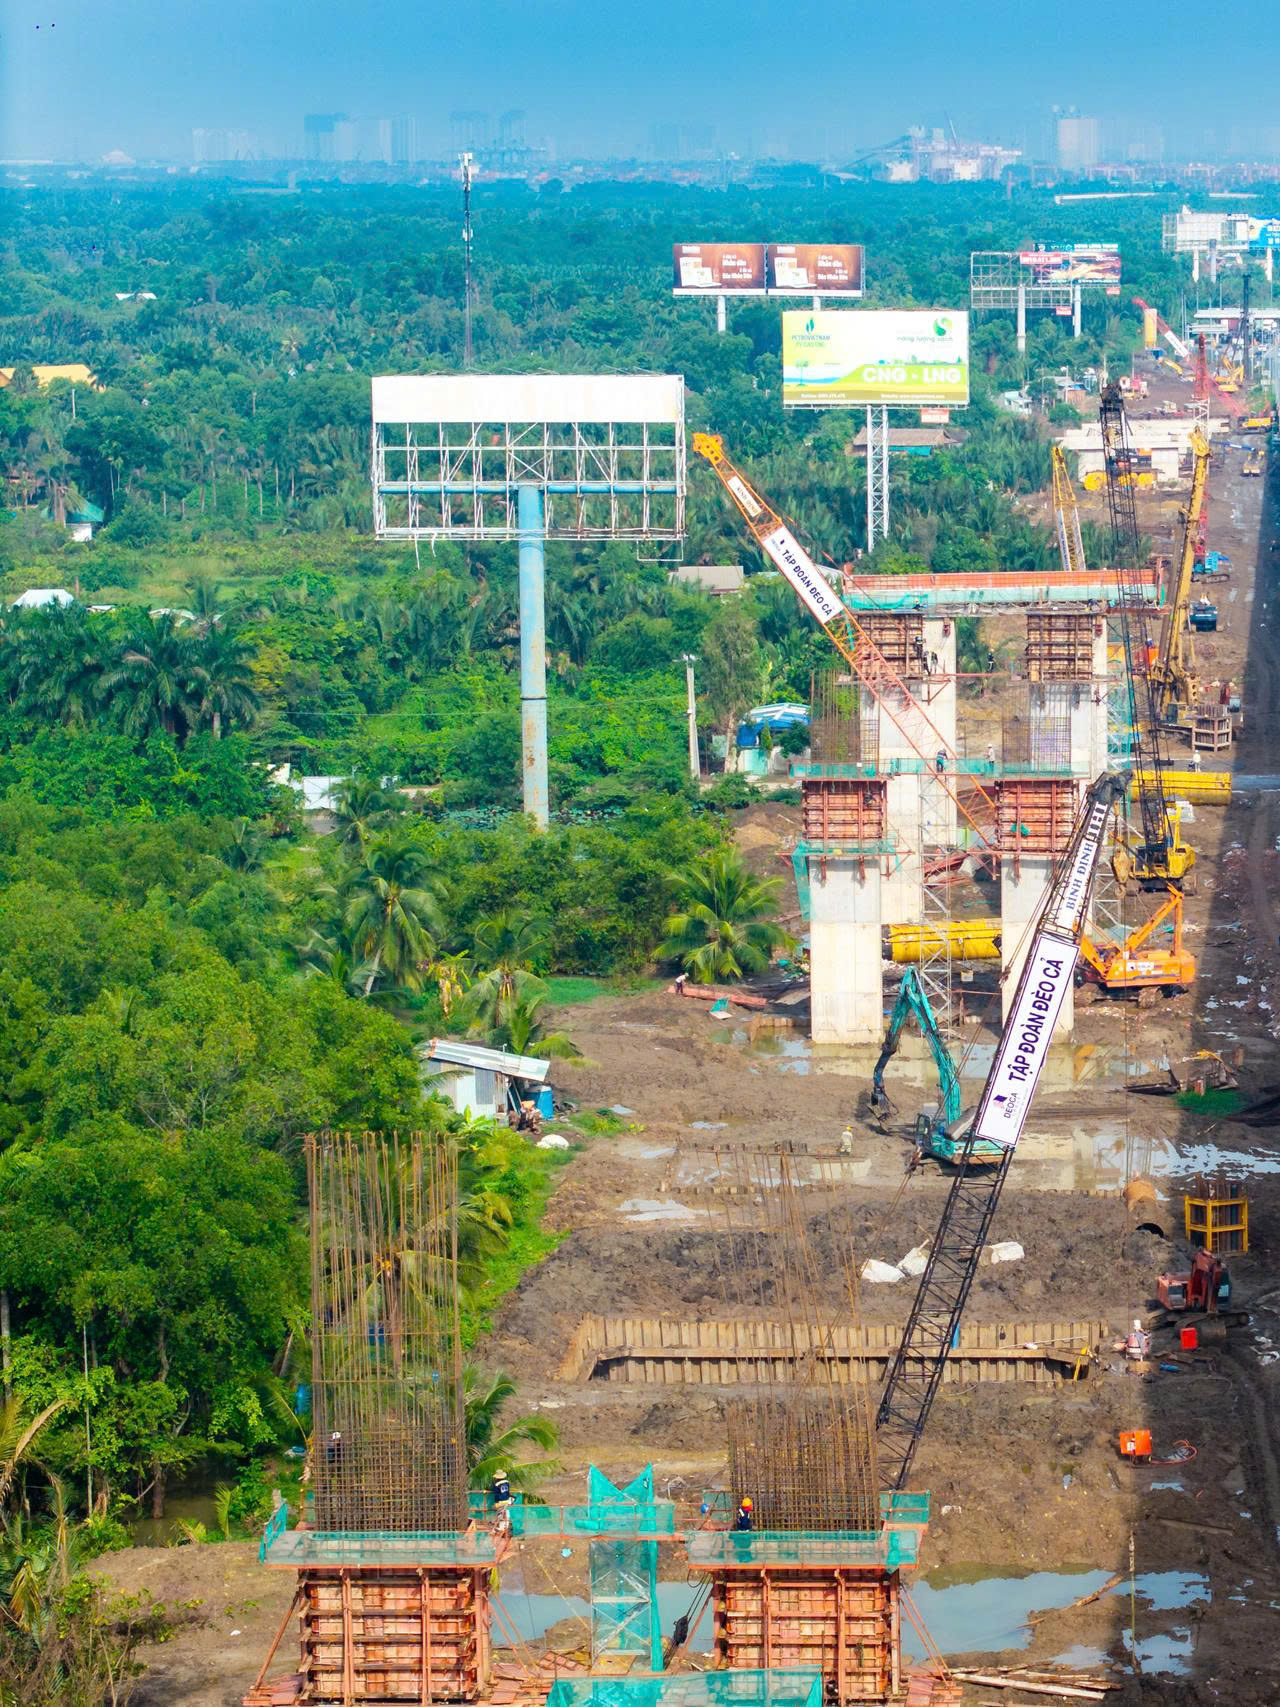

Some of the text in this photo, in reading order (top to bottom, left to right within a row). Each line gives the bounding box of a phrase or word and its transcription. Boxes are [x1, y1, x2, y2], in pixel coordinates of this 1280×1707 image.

[863, 367, 961, 383] CNG LNG
[1040, 956, 1065, 980] CẢ
[1030, 980, 1056, 1013] ĐÈO
[1017, 1012, 1047, 1055] ĐOÀN
[1007, 1054, 1034, 1081] TẬP
[1003, 1092, 1018, 1119] DEOCA
